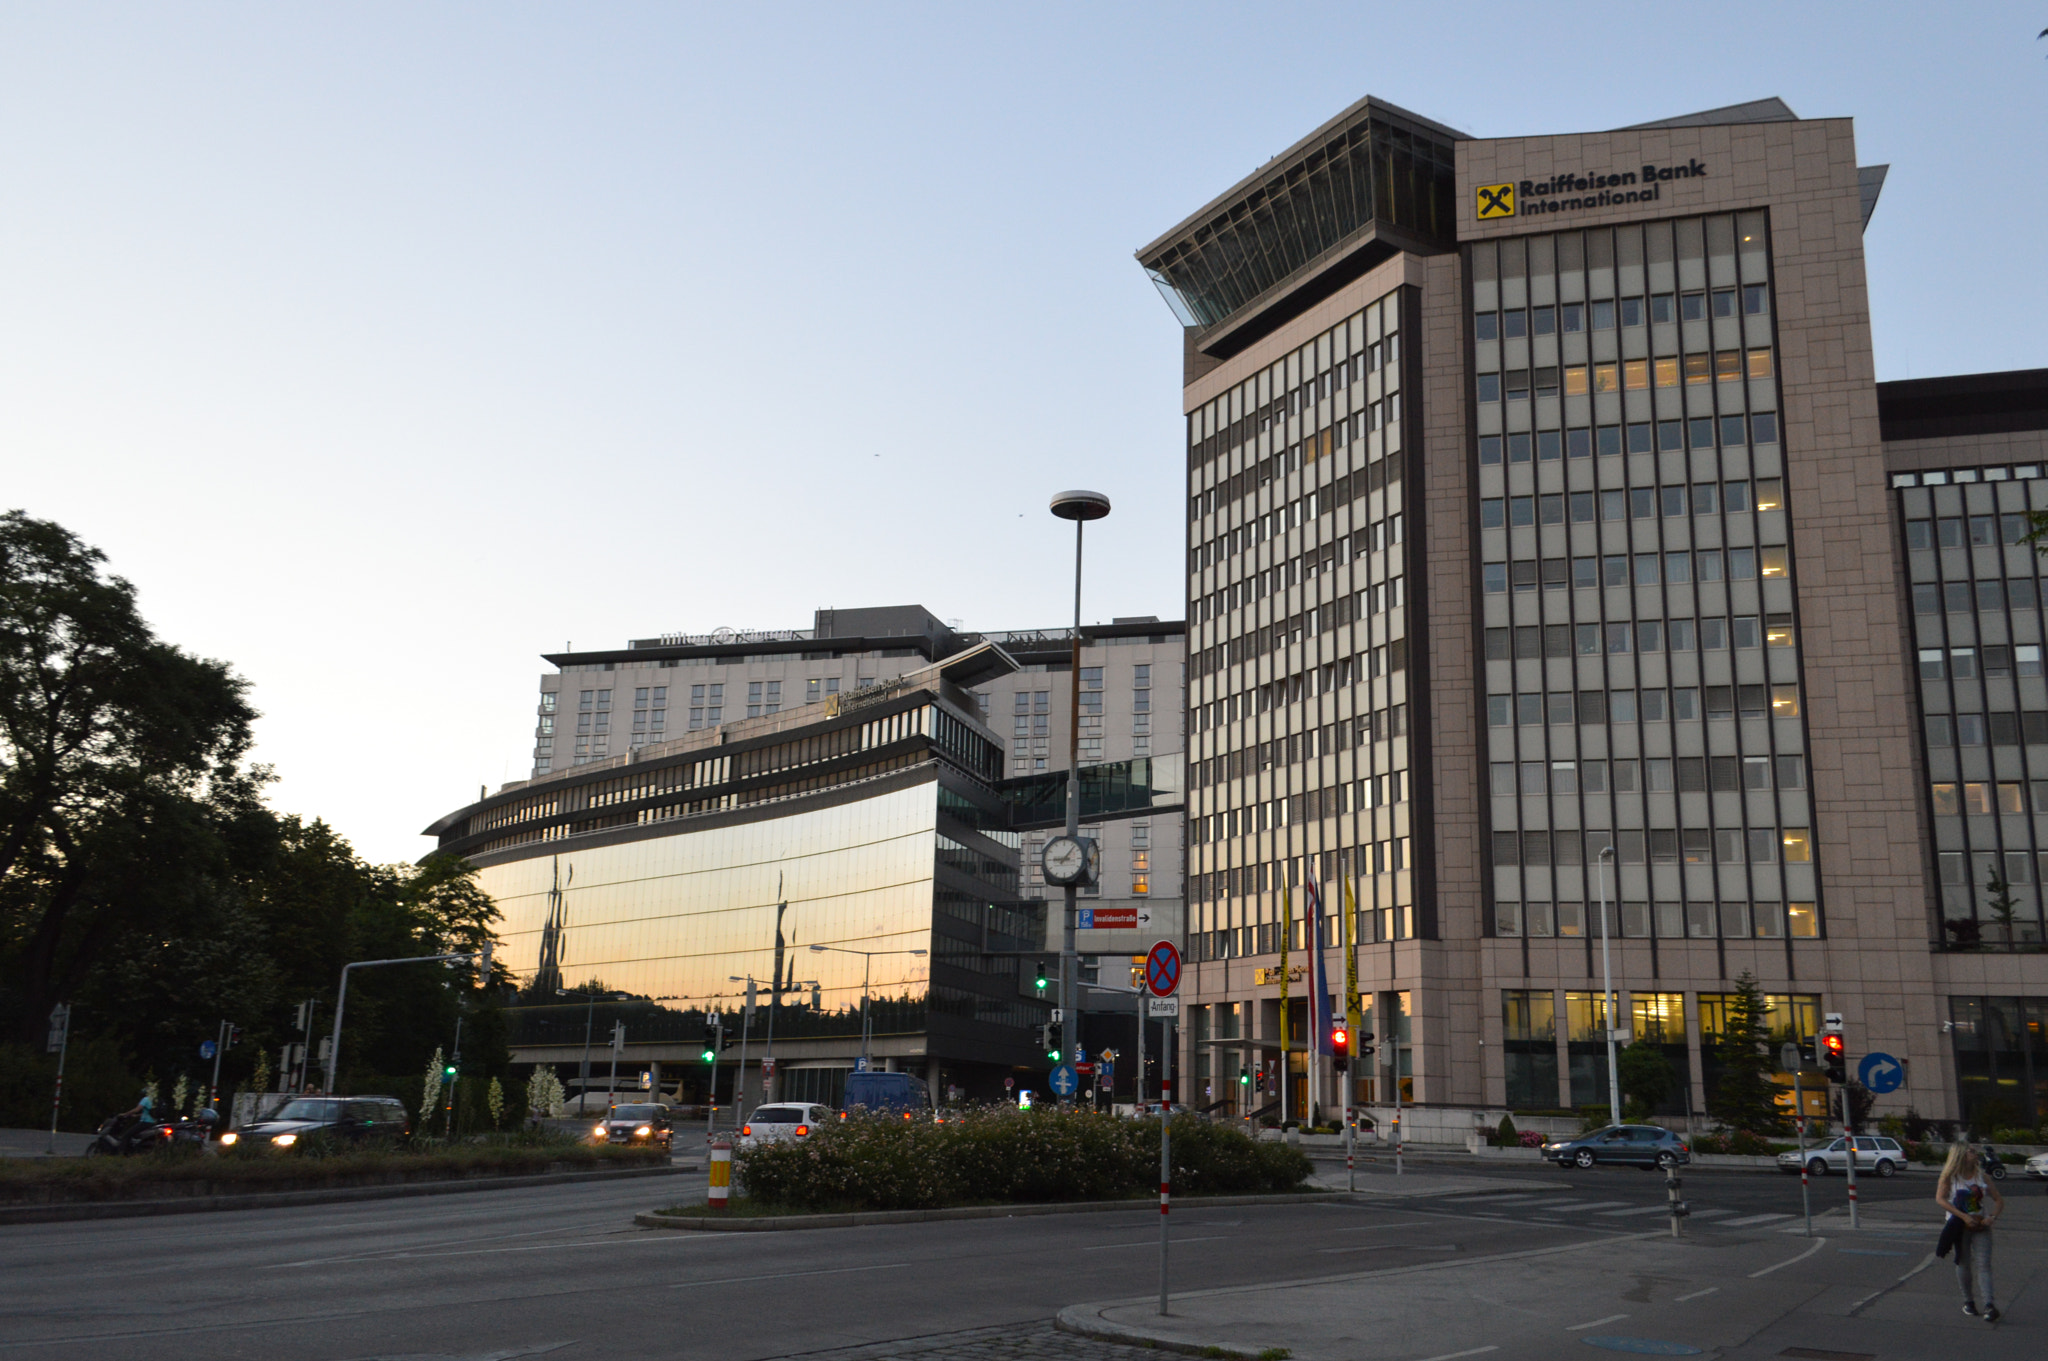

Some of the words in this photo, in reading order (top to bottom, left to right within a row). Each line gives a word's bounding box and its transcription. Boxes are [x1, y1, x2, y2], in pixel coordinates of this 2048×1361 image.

[1519, 171, 1636, 198] Raiffeisen
[1641, 158, 1706, 184] Bank
[1519, 182, 1660, 217] International
[660, 631, 707, 646] Hilton
[841, 690, 888, 713] International
[843, 684, 882, 702] Raiffeisen
[883, 673, 905, 690] Bank
